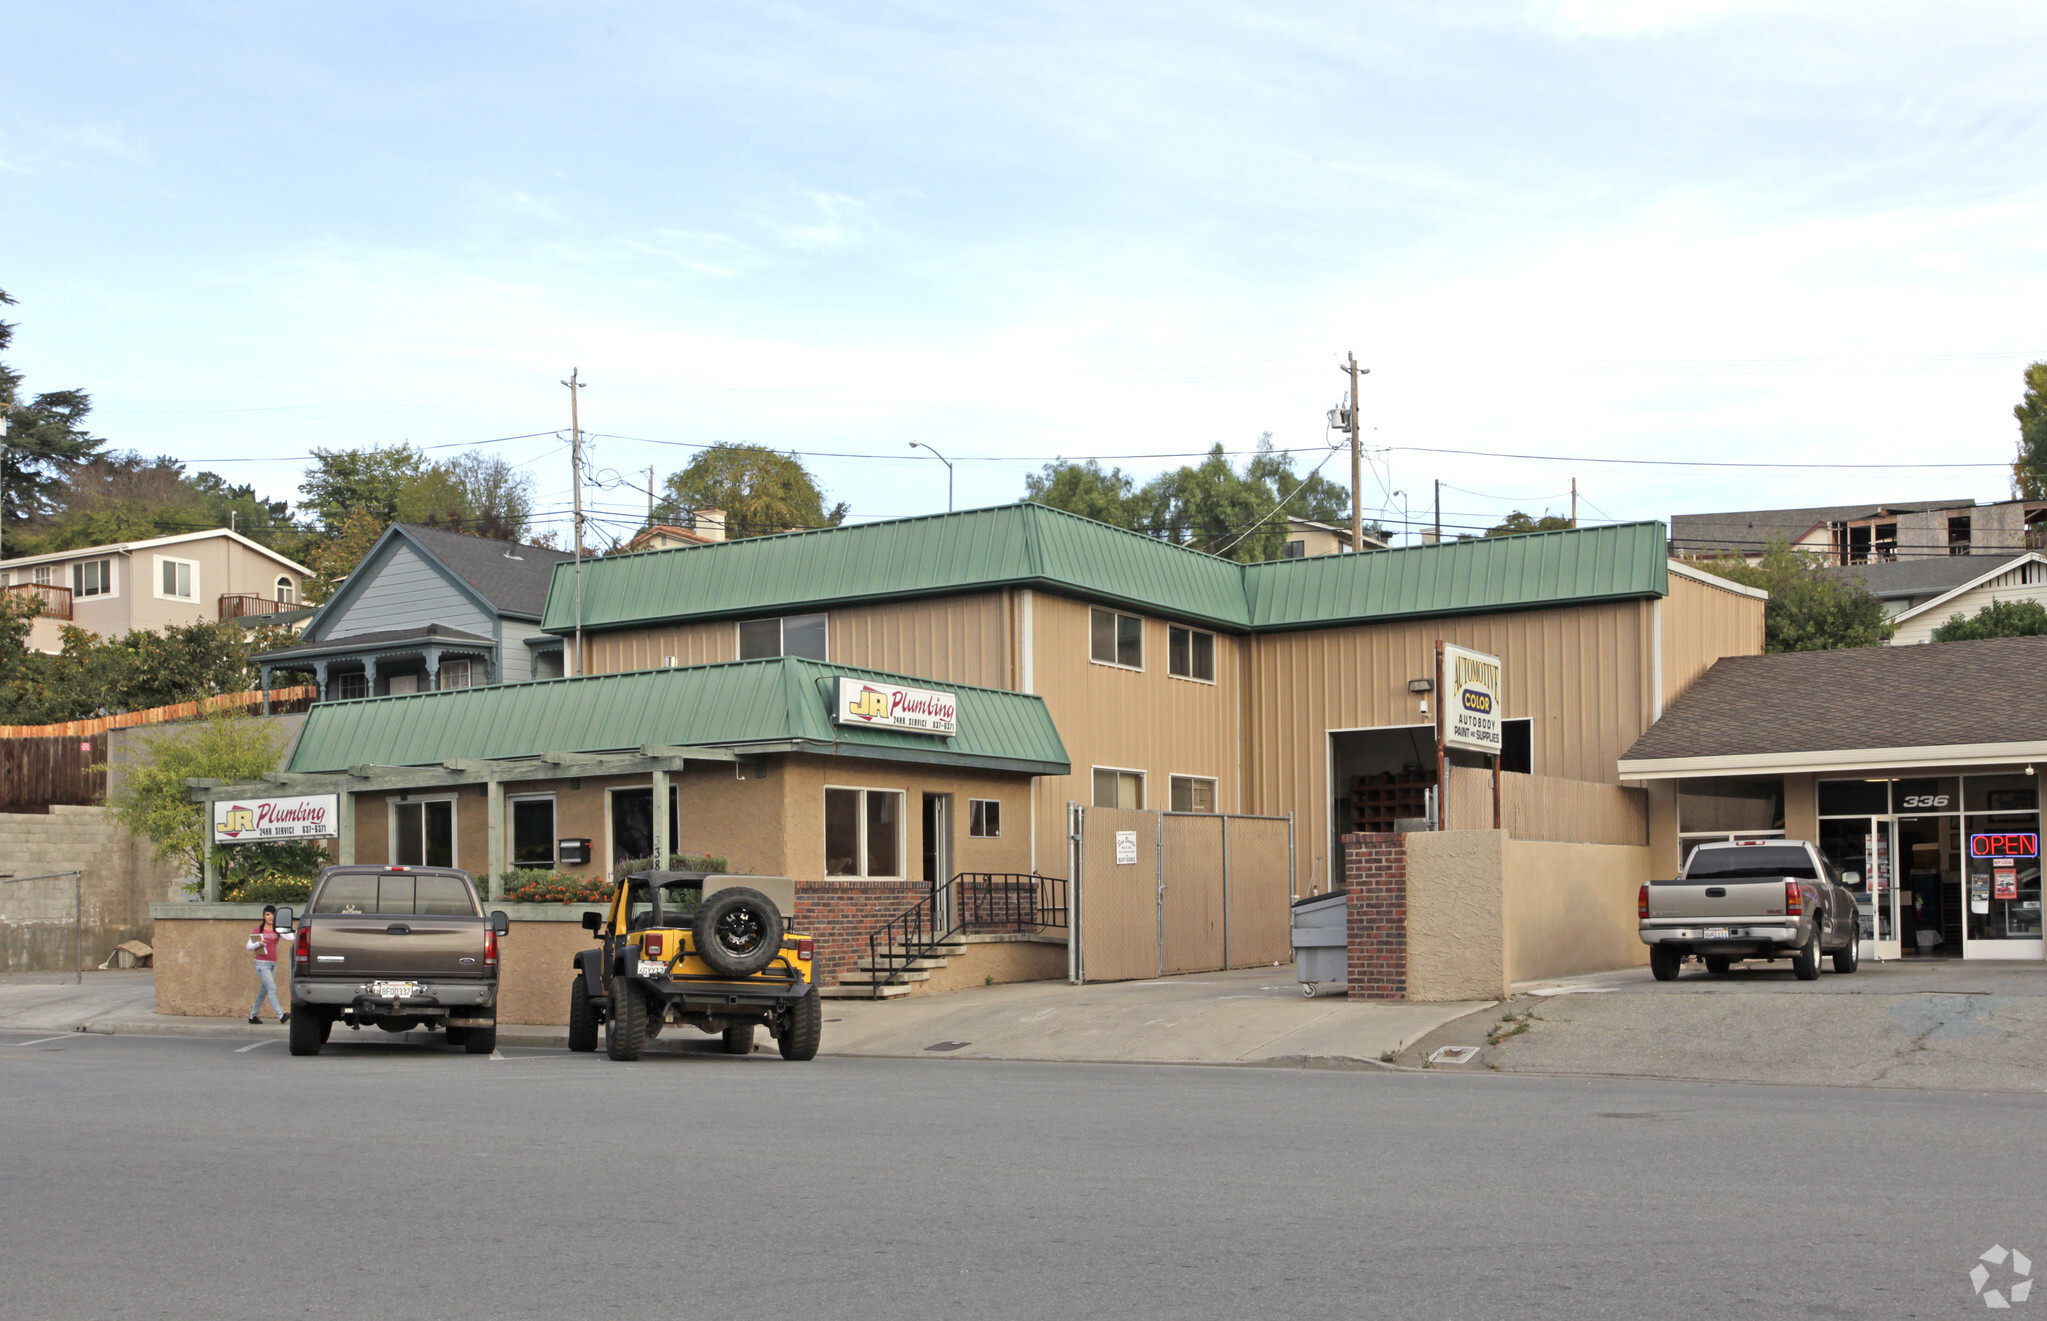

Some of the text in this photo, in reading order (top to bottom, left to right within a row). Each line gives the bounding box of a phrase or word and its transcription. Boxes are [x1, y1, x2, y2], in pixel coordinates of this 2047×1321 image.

[1453, 656, 1499, 708] AUTOMOTIVE
[849, 690, 954, 722] JR Plumbing
[1464, 693, 1490, 711] COLOR
[908, 717, 927, 728] SERVICE
[1458, 713, 1496, 730] AUTOBODY
[1454, 725, 1470, 738] PAINT
[1476, 729, 1500, 743] SUPPLIES
[1903, 795, 1950, 808] 336
[216, 801, 326, 833] JR Plumbing
[275, 826, 295, 836] SERVICE
[302, 825, 327, 834] 637-6371
[1972, 834, 2036, 855] OPEN
